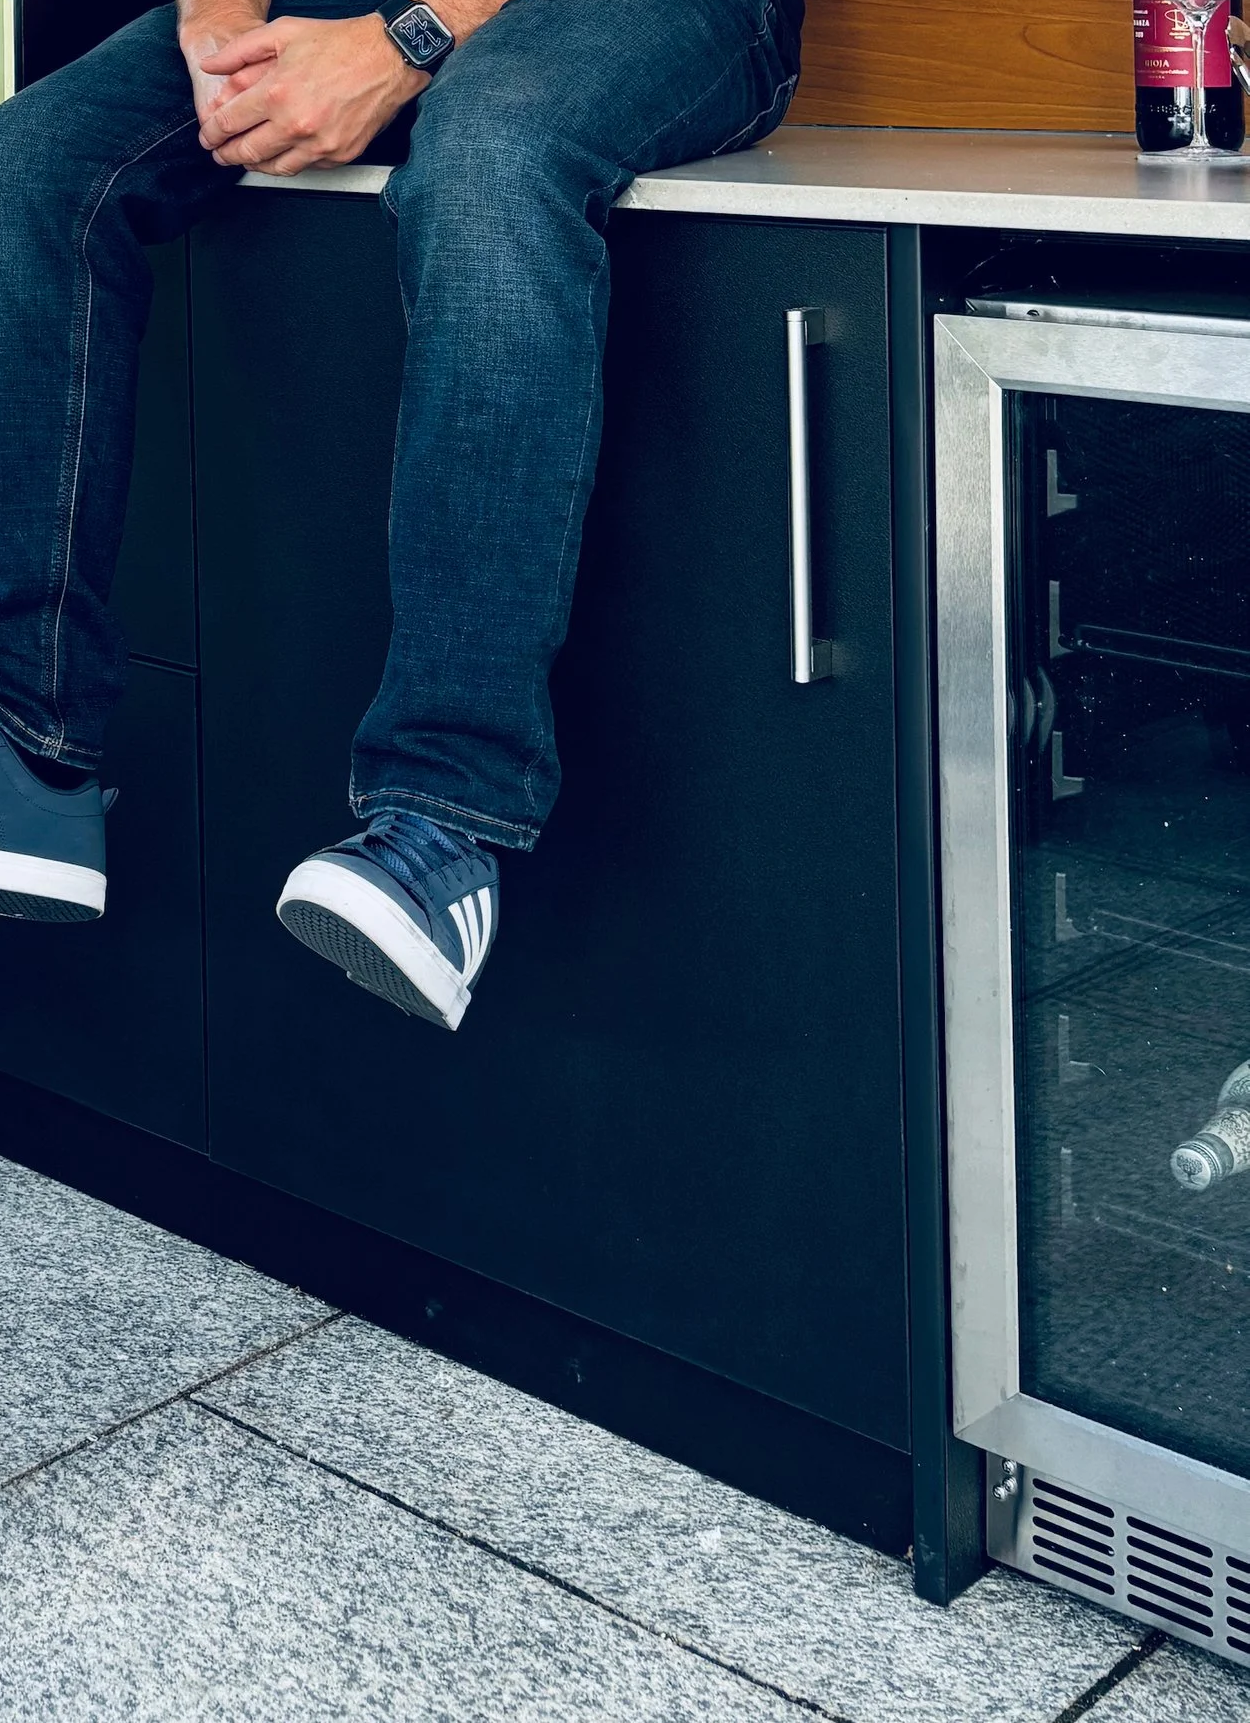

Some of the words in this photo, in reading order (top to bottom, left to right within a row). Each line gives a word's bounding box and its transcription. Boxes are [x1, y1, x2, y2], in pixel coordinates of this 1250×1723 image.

[399, 13, 427, 40] 14
[411, 30, 441, 56] 12
[1144, 59, 1170, 68] RIOJA
